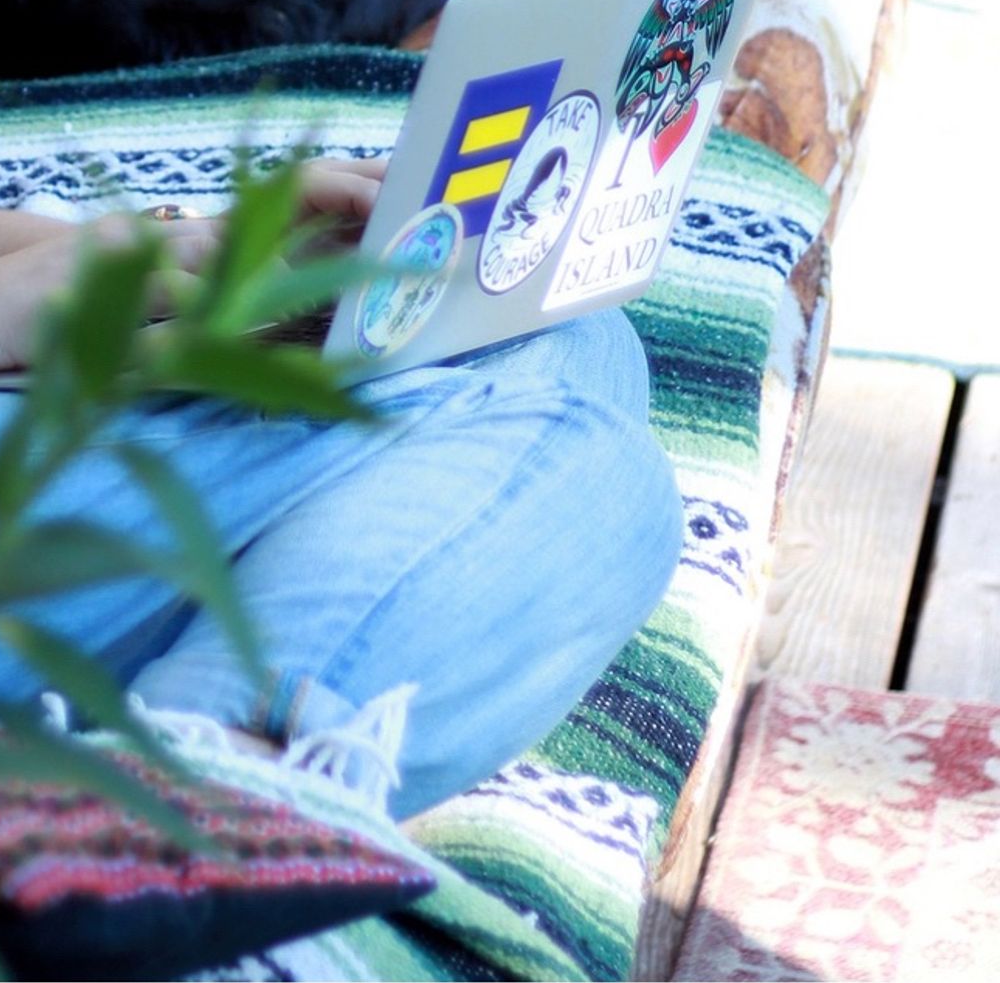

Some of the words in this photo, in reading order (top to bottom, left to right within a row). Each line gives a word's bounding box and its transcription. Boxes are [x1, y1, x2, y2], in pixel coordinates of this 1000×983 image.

[546, 99, 593, 136] TAKE
[579, 184, 675, 245] QUADRA
[484, 232, 550, 285] COURAGE
[554, 238, 657, 294] ISLAND
